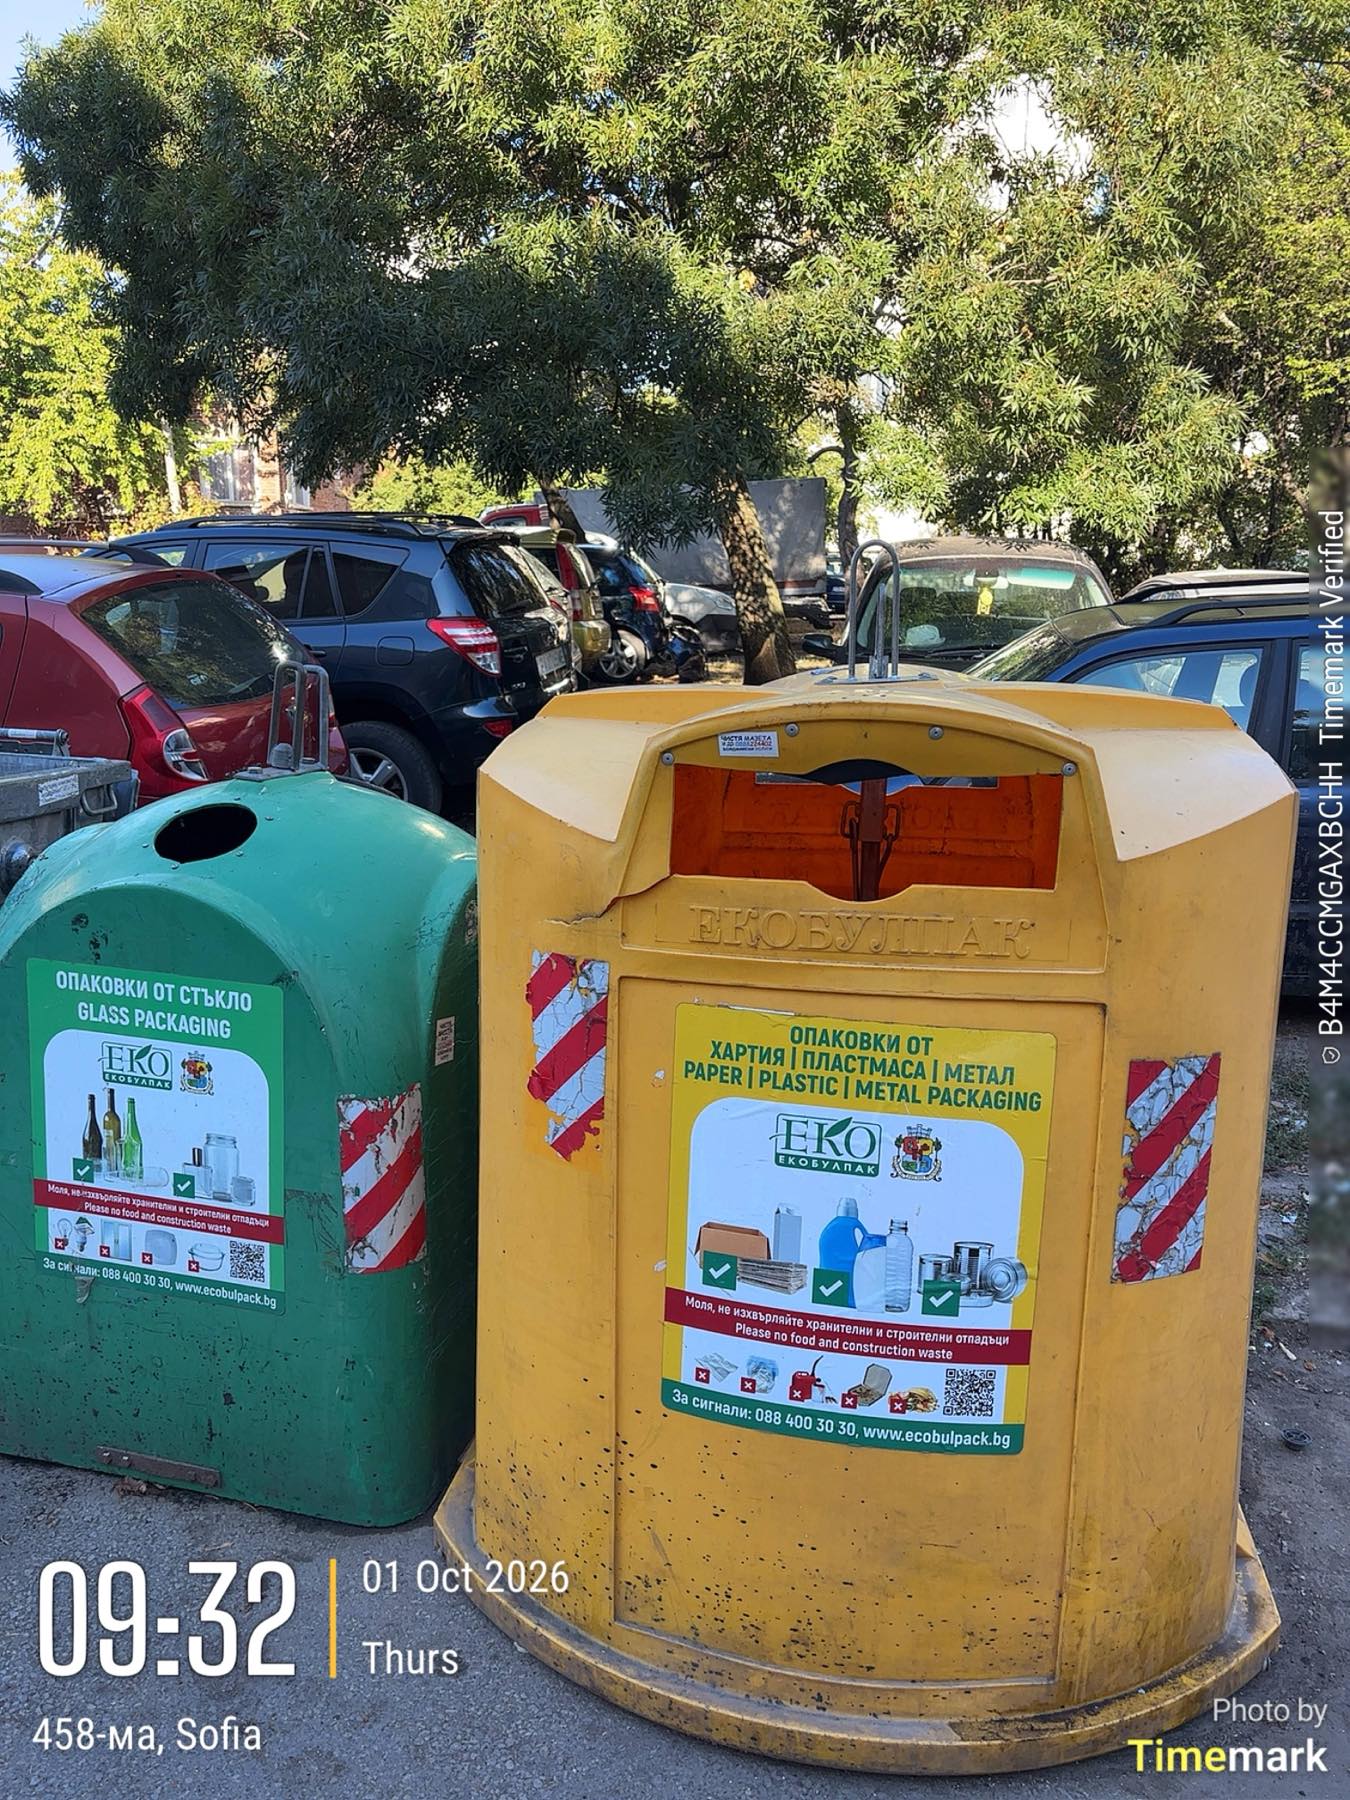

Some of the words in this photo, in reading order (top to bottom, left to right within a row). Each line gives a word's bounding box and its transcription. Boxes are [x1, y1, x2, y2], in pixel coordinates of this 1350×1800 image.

[689, 904, 1036, 959] ЕКОБУЛПАК
[56, 970, 148, 1000] ОПАКОВКИ
[153, 982, 173, 1002] ОТ
[179, 986, 253, 1012] СТЪКЛО
[77, 1001, 130, 1027] GLASS
[134, 1009, 232, 1039] PACKAGING
[789, 1026, 900, 1053] ОПАКОВКИ
[906, 1035, 934, 1056] ОТ
[104, 1073, 171, 1089] ЕКОБУЛПАК
[710, 1040, 785, 1066] ХАРТИЯ
[802, 1051, 926, 1080] ПЛАСТМАСА
[944, 1064, 1015, 1086] МЕТАЛ
[684, 1061, 742, 1086] PAPER
[759, 1069, 838, 1096] PLASTIC
[855, 1079, 921, 1105] METAL
[928, 1086, 1042, 1112] PACKAGING
[778, 1155, 876, 1175] ЕКОБУЛПАК
[48, 1184, 70, 1196] Моля,
[132, 1197, 177, 1212] хранителни
[185, 1207, 231, 1220] строителни
[232, 1214, 270, 1227] отпадъци
[84, 1202, 109, 1214] Please
[111, 1207, 120, 1216] no
[122, 1208, 139, 1218] food
[141, 1212, 156, 1221] and
[156, 1214, 206, 1229] construction
[207, 1223, 232, 1234] waste
[43, 1257, 56, 1269] За
[102, 1267, 121, 1280] 088
[122, 1270, 141, 1284] 400
[143, 1274, 156, 1286] 30
[157, 1276, 173, 1291] 30,
[175, 1280, 277, 1309] www.ecobulpack.bg
[685, 1295, 715, 1314] Моля,
[718, 1304, 731, 1315] не
[733, 1307, 804, 1327] изхвърляйте
[806, 1319, 873, 1337] хранителни
[876, 1328, 883, 1337] и
[886, 1329, 953, 1343] строителни
[955, 1333, 1009, 1346] отпадъци
[735, 1322, 771, 1339] Please
[774, 1331, 787, 1342] no
[790, 1332, 816, 1346] food
[818, 1337, 839, 1349] and
[842, 1341, 915, 1357] construction
[918, 1348, 953, 1360] waste
[672, 1388, 689, 1405] За
[692, 1396, 752, 1420] сигнали:
[755, 1408, 782, 1426] 088
[785, 1412, 813, 1431] 400
[816, 1417, 835, 1434] 30
[837, 1421, 859, 1439] 30,
[863, 1427, 1011, 1449] www.ecobulpack.bg
